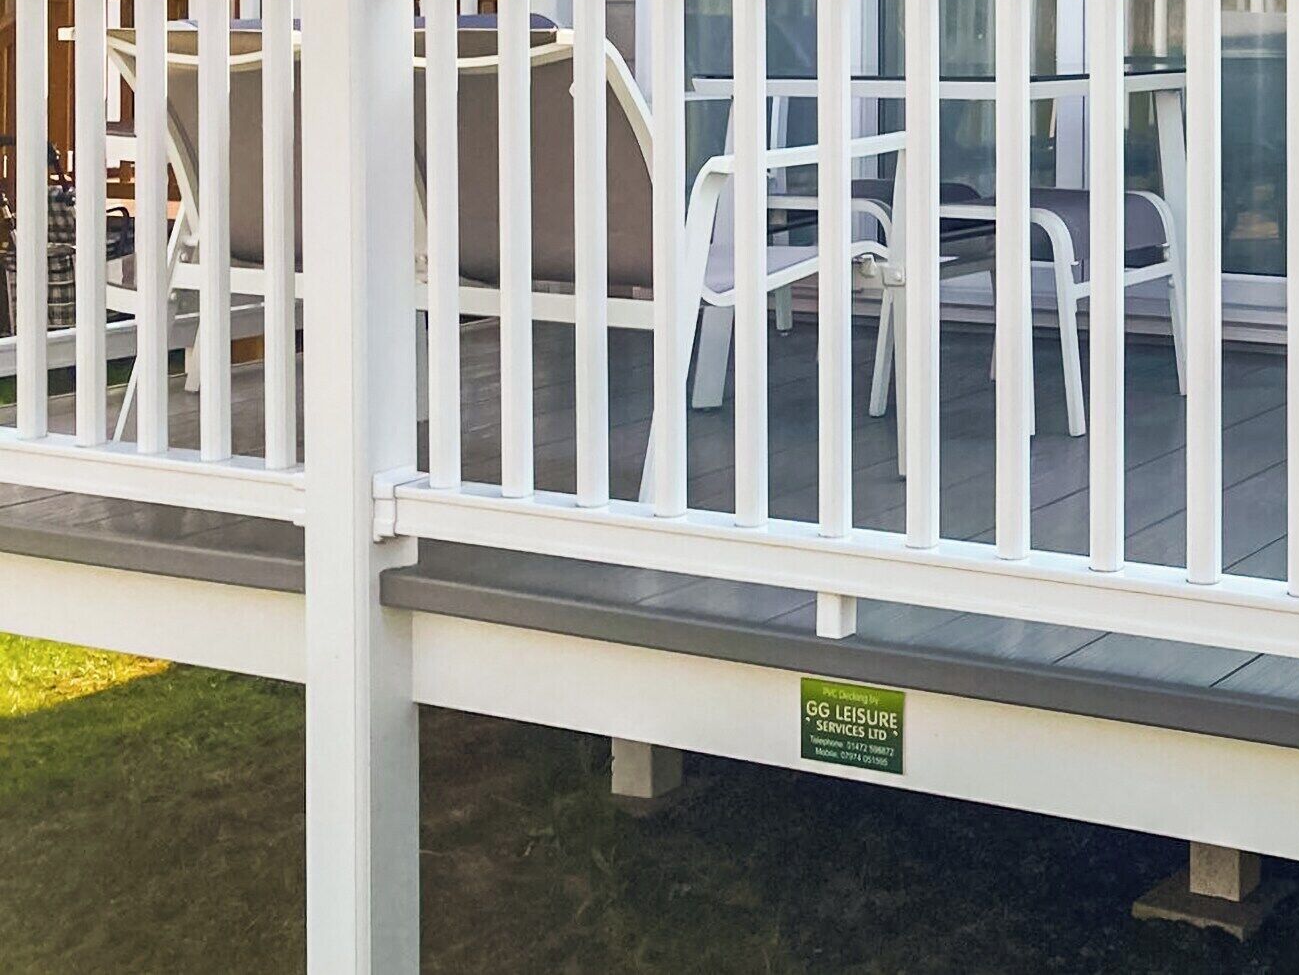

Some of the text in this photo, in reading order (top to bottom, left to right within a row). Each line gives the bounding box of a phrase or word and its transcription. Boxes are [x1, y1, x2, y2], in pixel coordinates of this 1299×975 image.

[806, 700, 898, 729] GG LEISURE
[816, 719, 887, 741] SERVICES LTD
